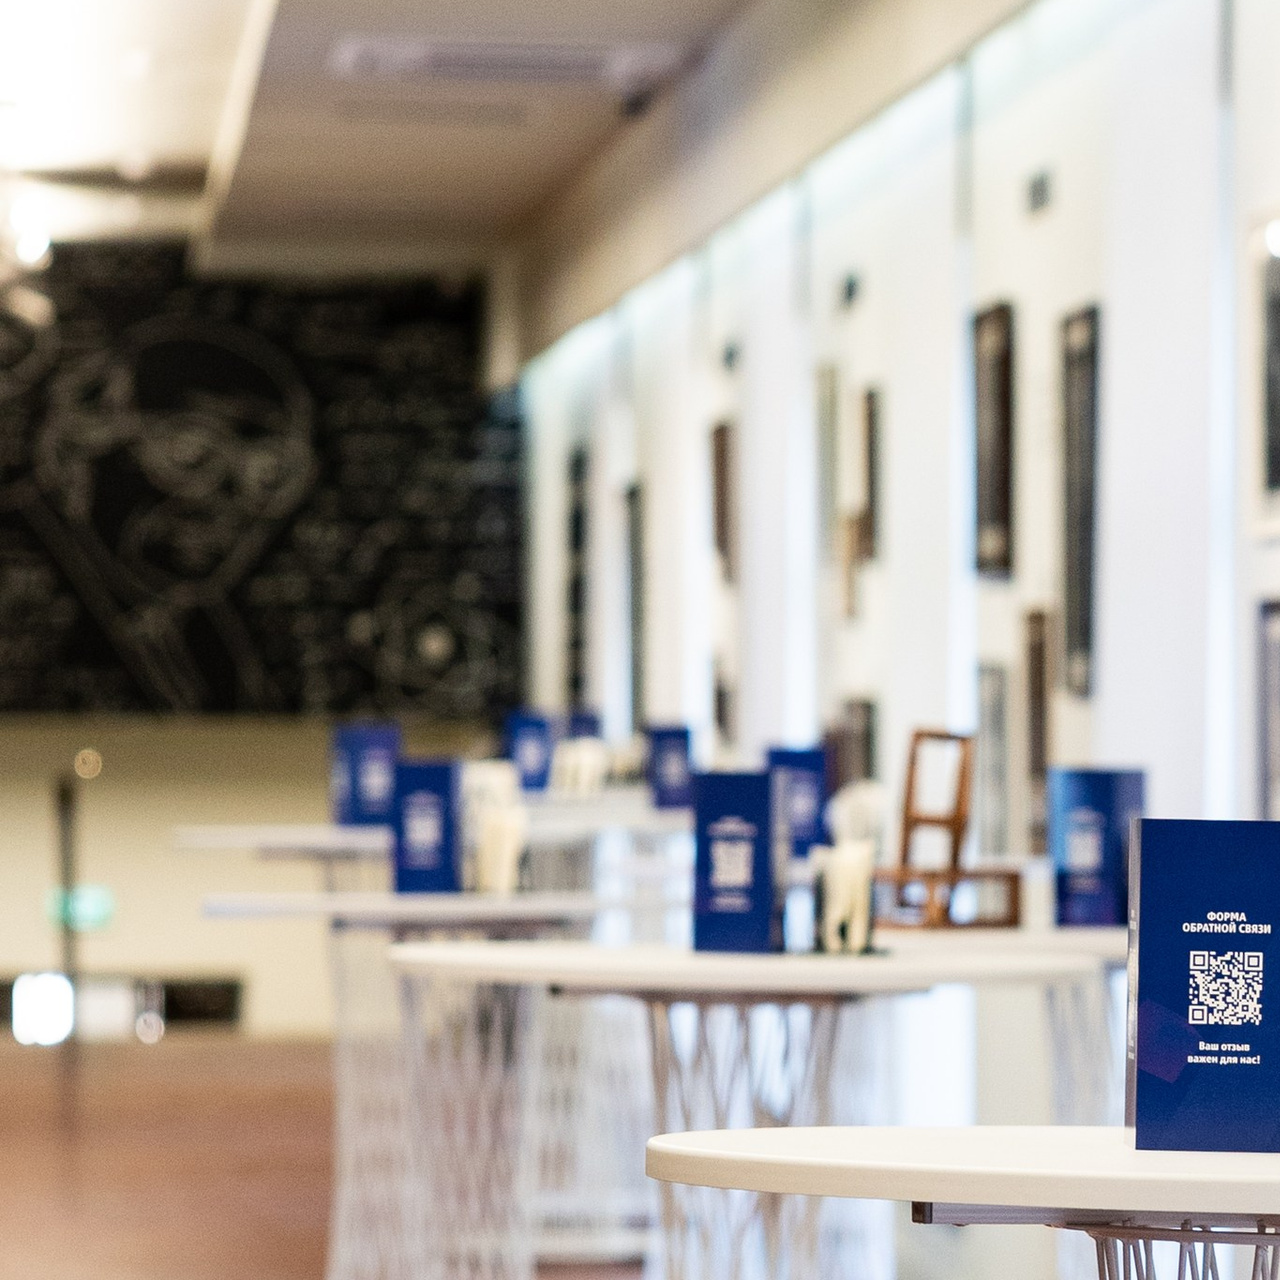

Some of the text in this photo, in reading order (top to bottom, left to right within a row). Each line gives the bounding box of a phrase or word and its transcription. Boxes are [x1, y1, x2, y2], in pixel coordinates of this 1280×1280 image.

[1206, 911, 1247, 922] ФОРМА
[1182, 921, 1272, 934] ОБРАТНОЙ СВЯЗИ
[1198, 1041, 1251, 1052] Ваш отзыв
[1187, 1055, 1261, 1065] важен для нас!
